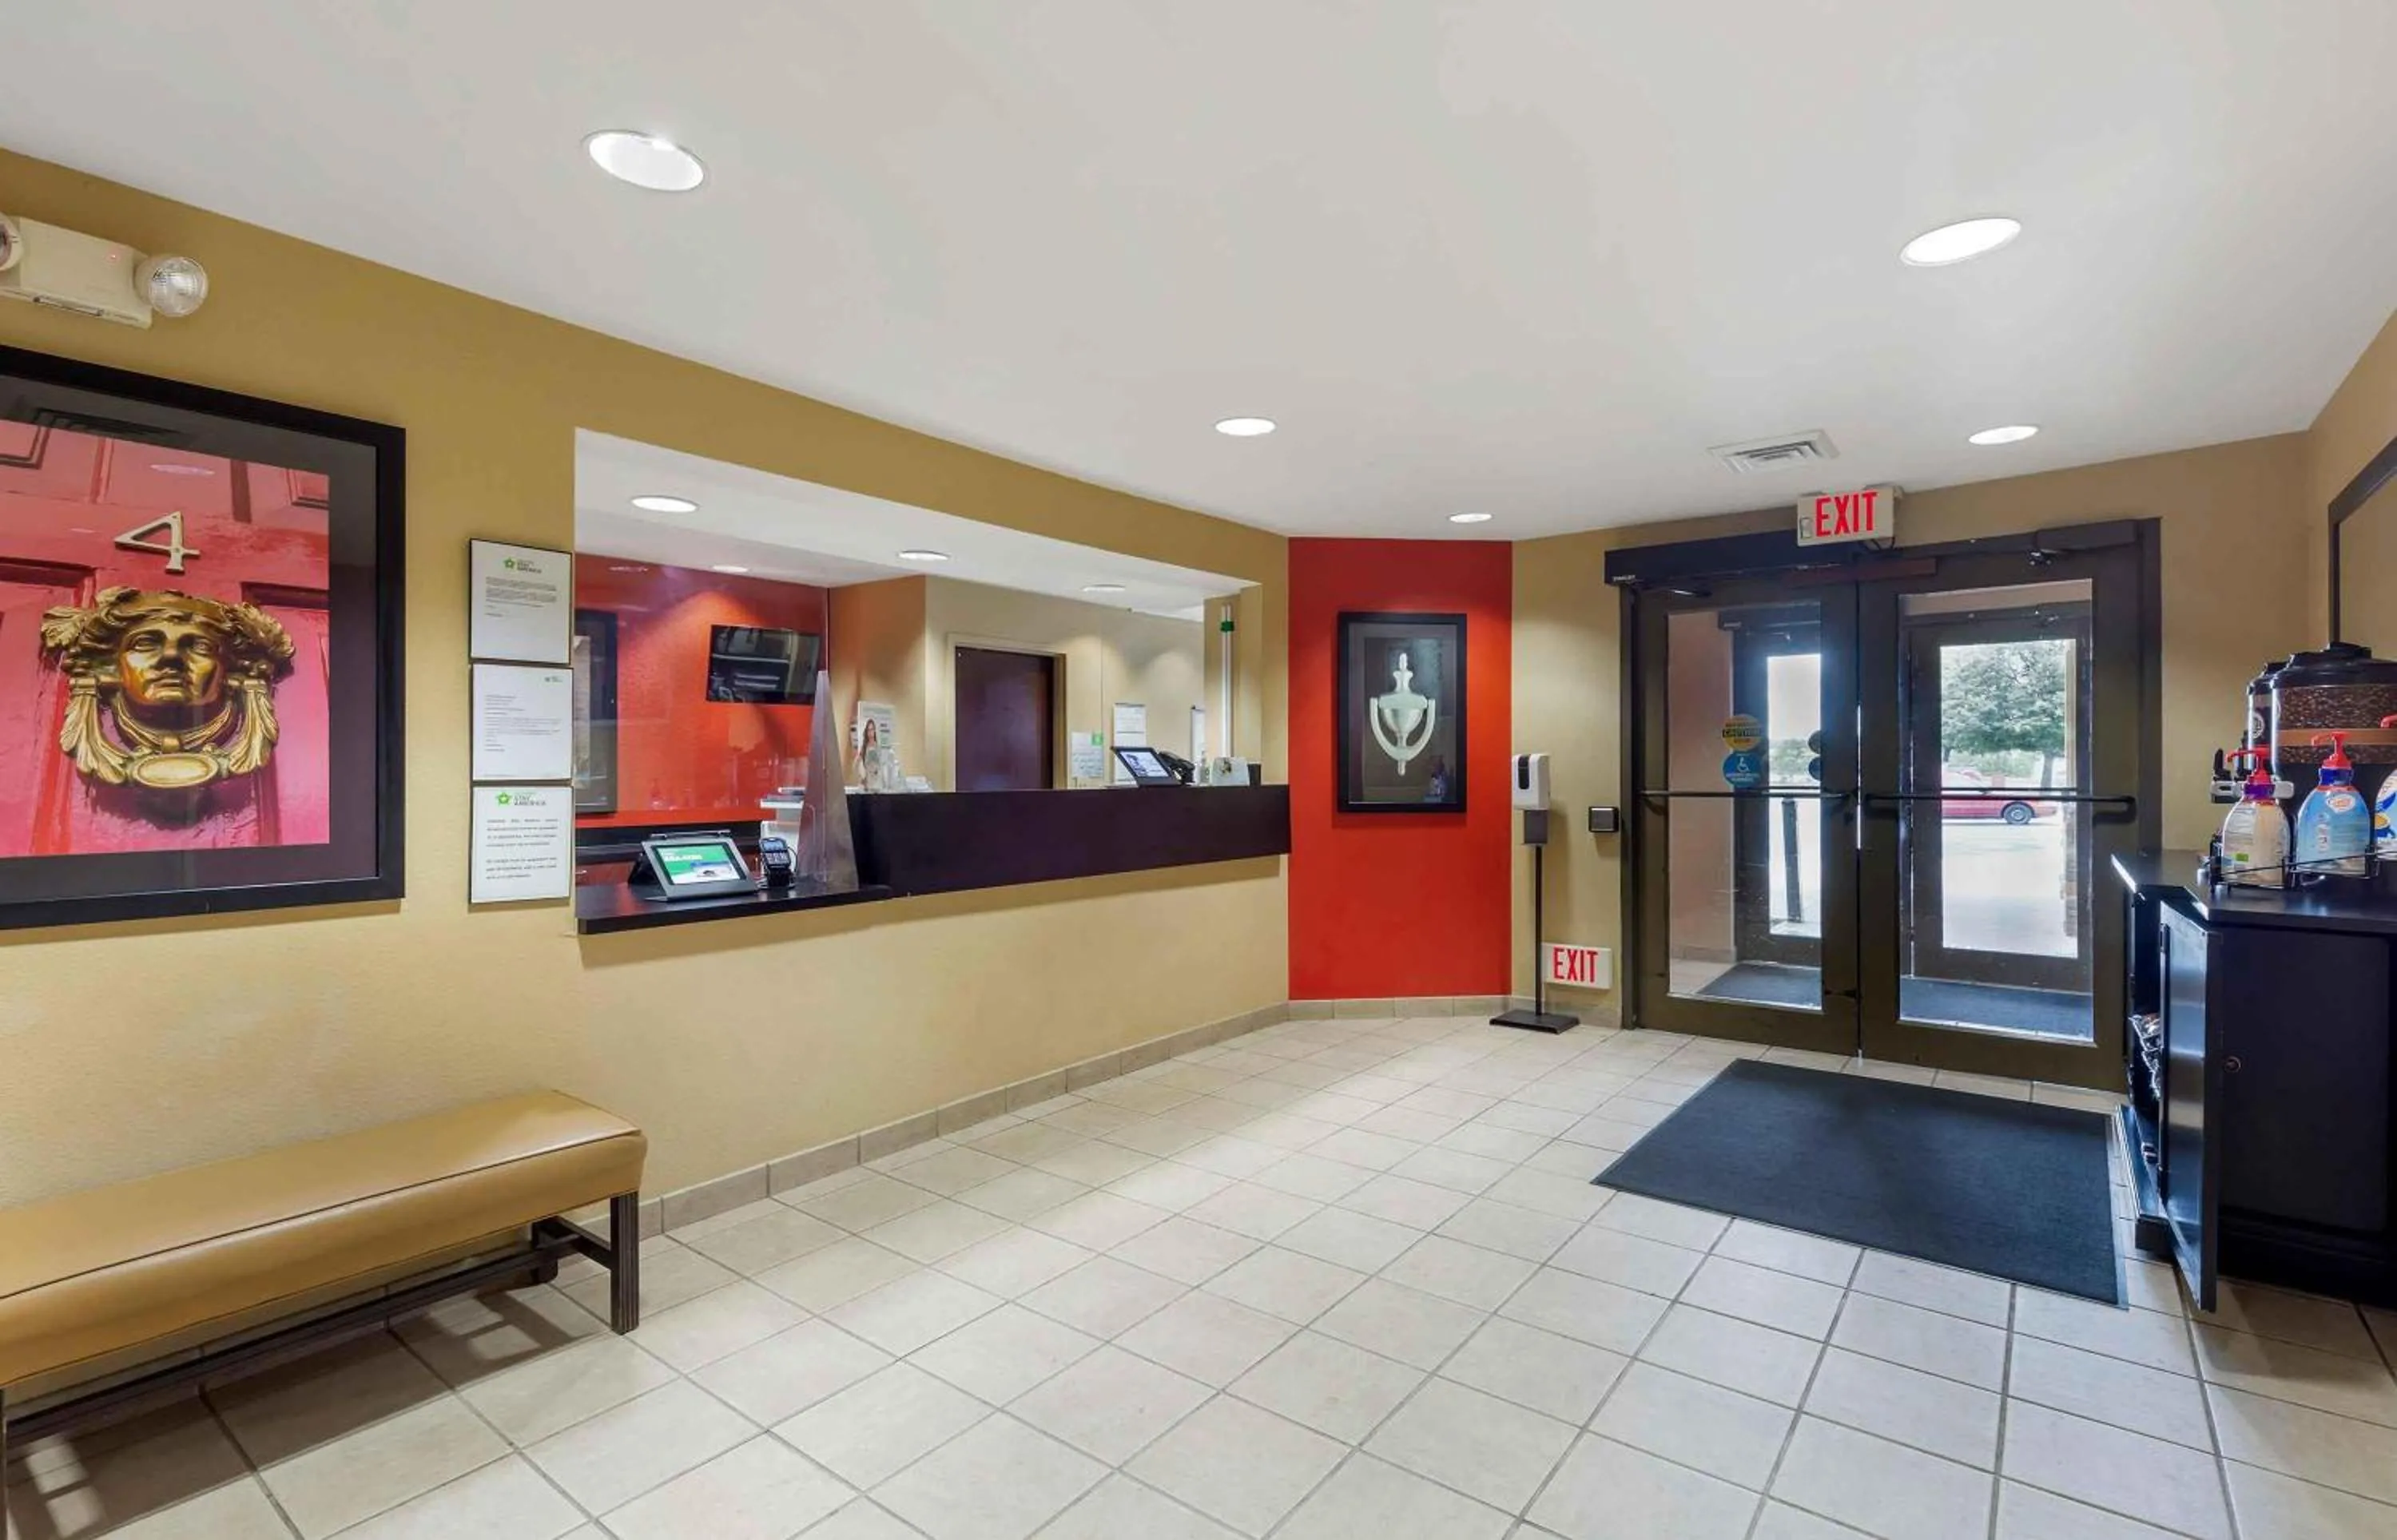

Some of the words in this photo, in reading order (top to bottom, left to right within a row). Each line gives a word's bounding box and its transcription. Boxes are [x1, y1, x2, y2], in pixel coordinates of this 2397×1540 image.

[1815, 490, 1878, 538] EXIT
[114, 510, 200, 572] 4
[1552, 947, 1599, 983] EXIT
